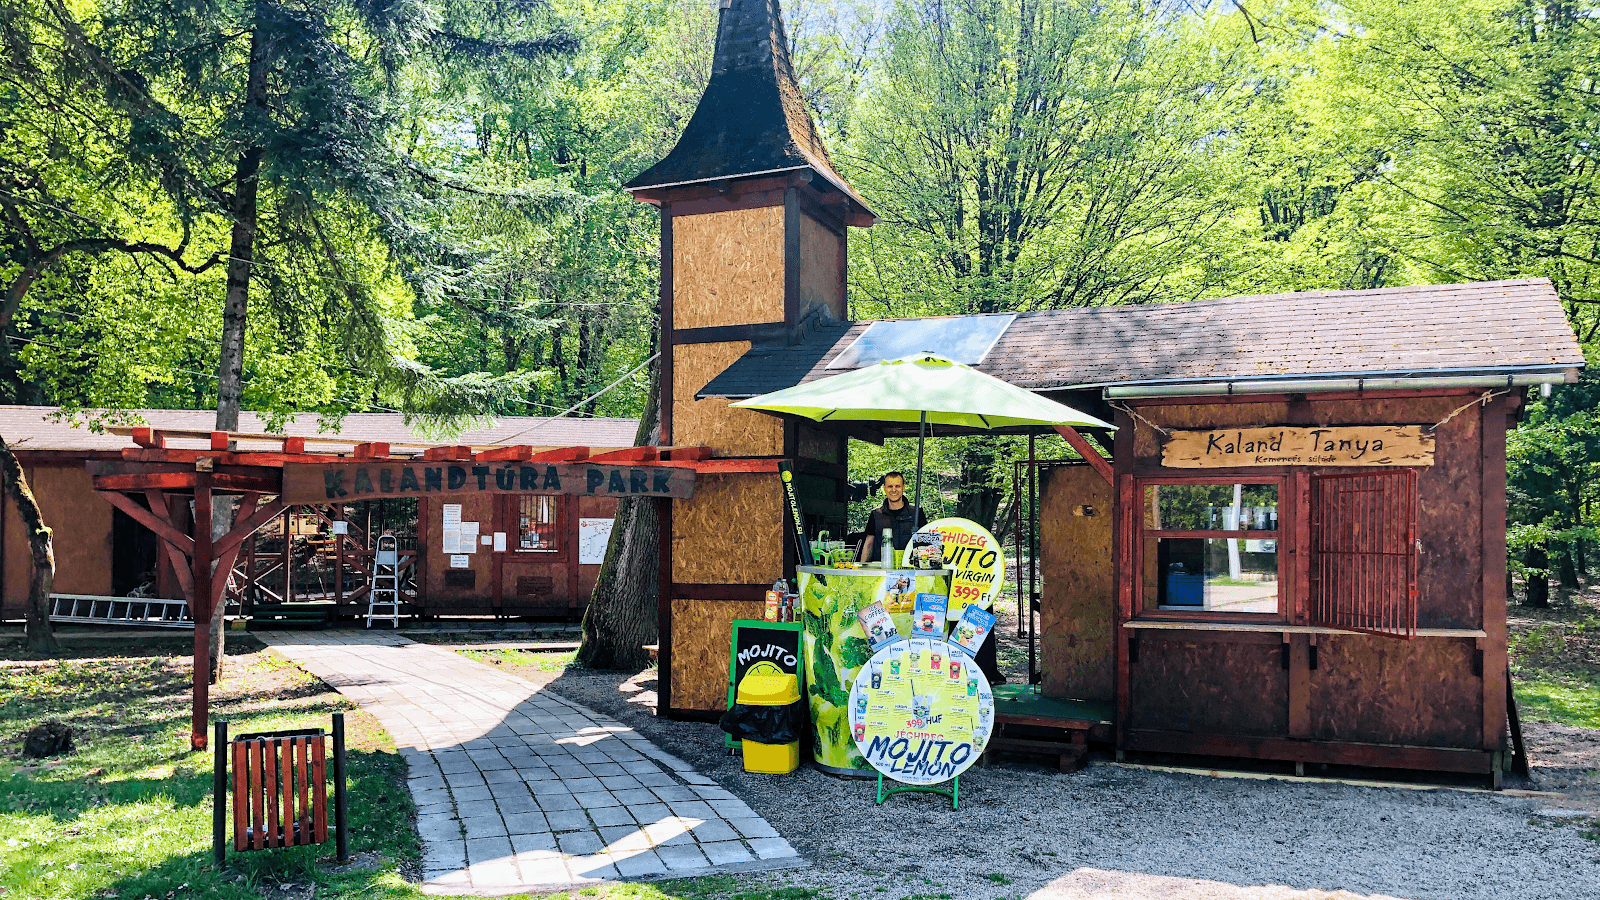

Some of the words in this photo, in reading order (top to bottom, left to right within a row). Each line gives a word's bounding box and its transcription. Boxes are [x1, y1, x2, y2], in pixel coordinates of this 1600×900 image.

[1206, 431, 1284, 455] Kaland
[1310, 429, 1384, 459] Tanya
[323, 463, 562, 498] KALANDTÚRA
[586, 468, 673, 494] PARK
[929, 527, 987, 548] GHIDEG
[955, 569, 995, 583] VIRGIN
[953, 586, 980, 601] 399
[981, 593, 991, 602] Ft
[737, 644, 797, 666] MOJITO
[906, 718, 922, 728] 399
[926, 714, 942, 725] HUF
[866, 735, 971, 765] MOJITO
[890, 760, 956, 778] LEMON
